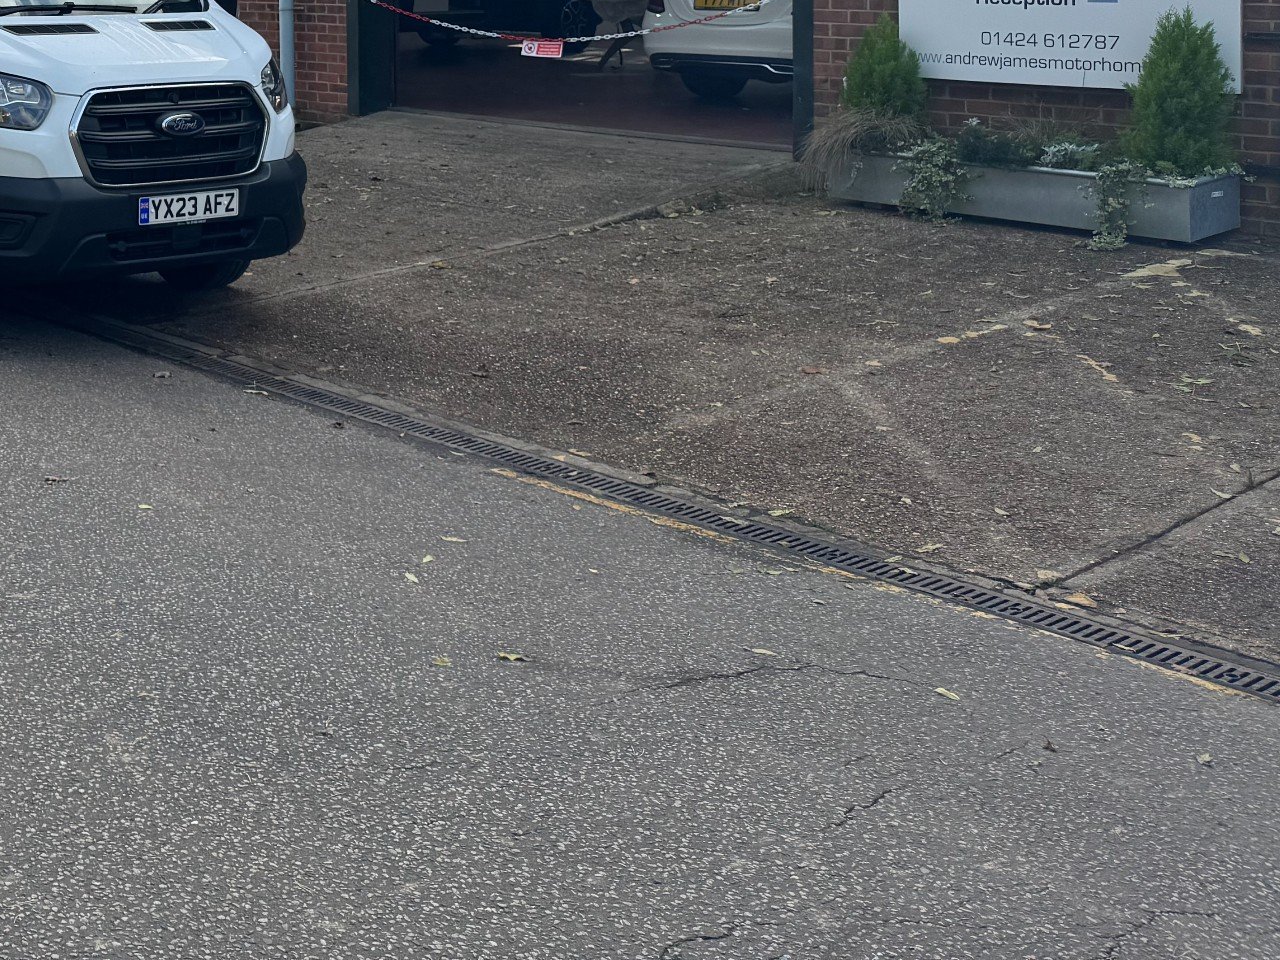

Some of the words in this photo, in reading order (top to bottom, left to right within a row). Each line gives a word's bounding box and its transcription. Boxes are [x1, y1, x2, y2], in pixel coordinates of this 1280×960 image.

[981, 31, 1038, 47] 01424
[1043, 32, 1120, 50] 612787
[917, 51, 1141, 73] ww.andrewjamesmotorhom
[152, 196, 198, 220] YX23
[203, 192, 235, 215] AFZ
